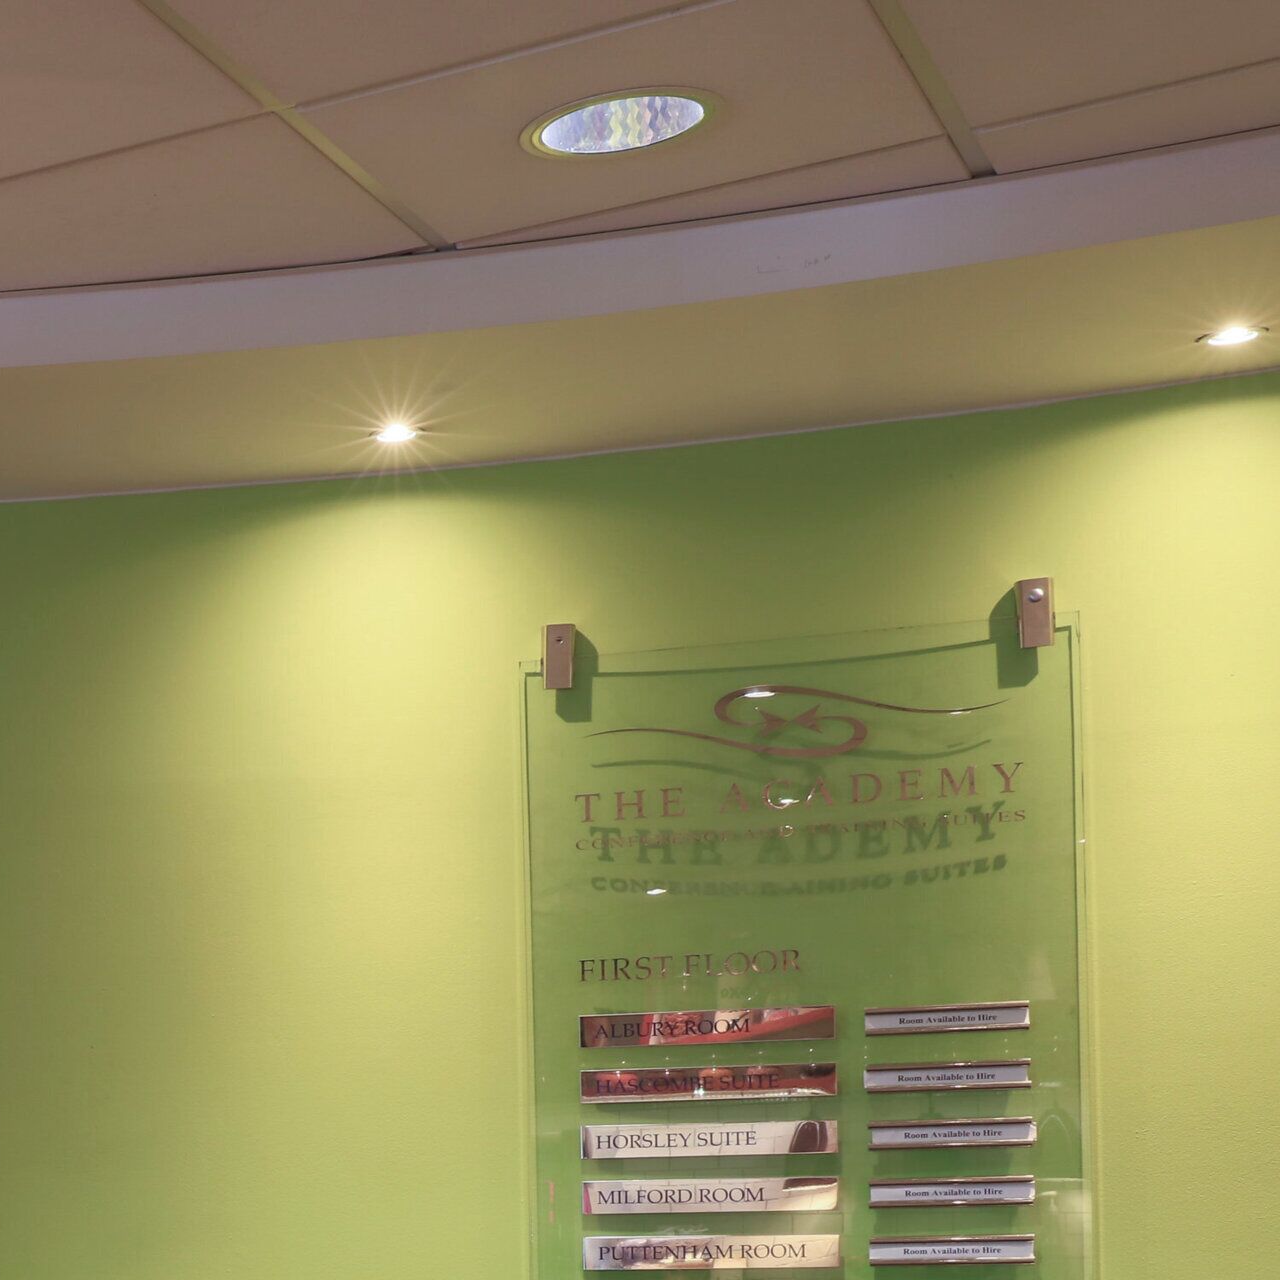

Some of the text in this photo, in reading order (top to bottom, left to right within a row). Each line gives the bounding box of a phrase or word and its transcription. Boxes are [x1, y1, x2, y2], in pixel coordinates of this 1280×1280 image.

[575, 762, 1024, 822] THE ACADEMY
[579, 949, 800, 982] FIRST FLOOR
[899, 1017, 923, 1025] Room
[926, 1015, 965, 1024] Available
[978, 1014, 997, 1022] Hire
[595, 1018, 751, 1039] ALBURY ROOM
[595, 1073, 781, 1094] HASCOMBE SUITE
[898, 1074, 922, 1082] Room
[925, 1073, 963, 1081] Available
[976, 1072, 996, 1080] Hire
[596, 1130, 757, 1149] HORSLEY SUITE
[983, 1129, 1002, 1137] Hire
[597, 1187, 765, 1205] MILFORD ROOM
[932, 1188, 970, 1196] Available
[984, 1187, 1003, 1195] Hire
[599, 1243, 806, 1260] PUTTENHAM ROOM
[930, 1246, 969, 1254] Available
[982, 1245, 1001, 1254] Hire
